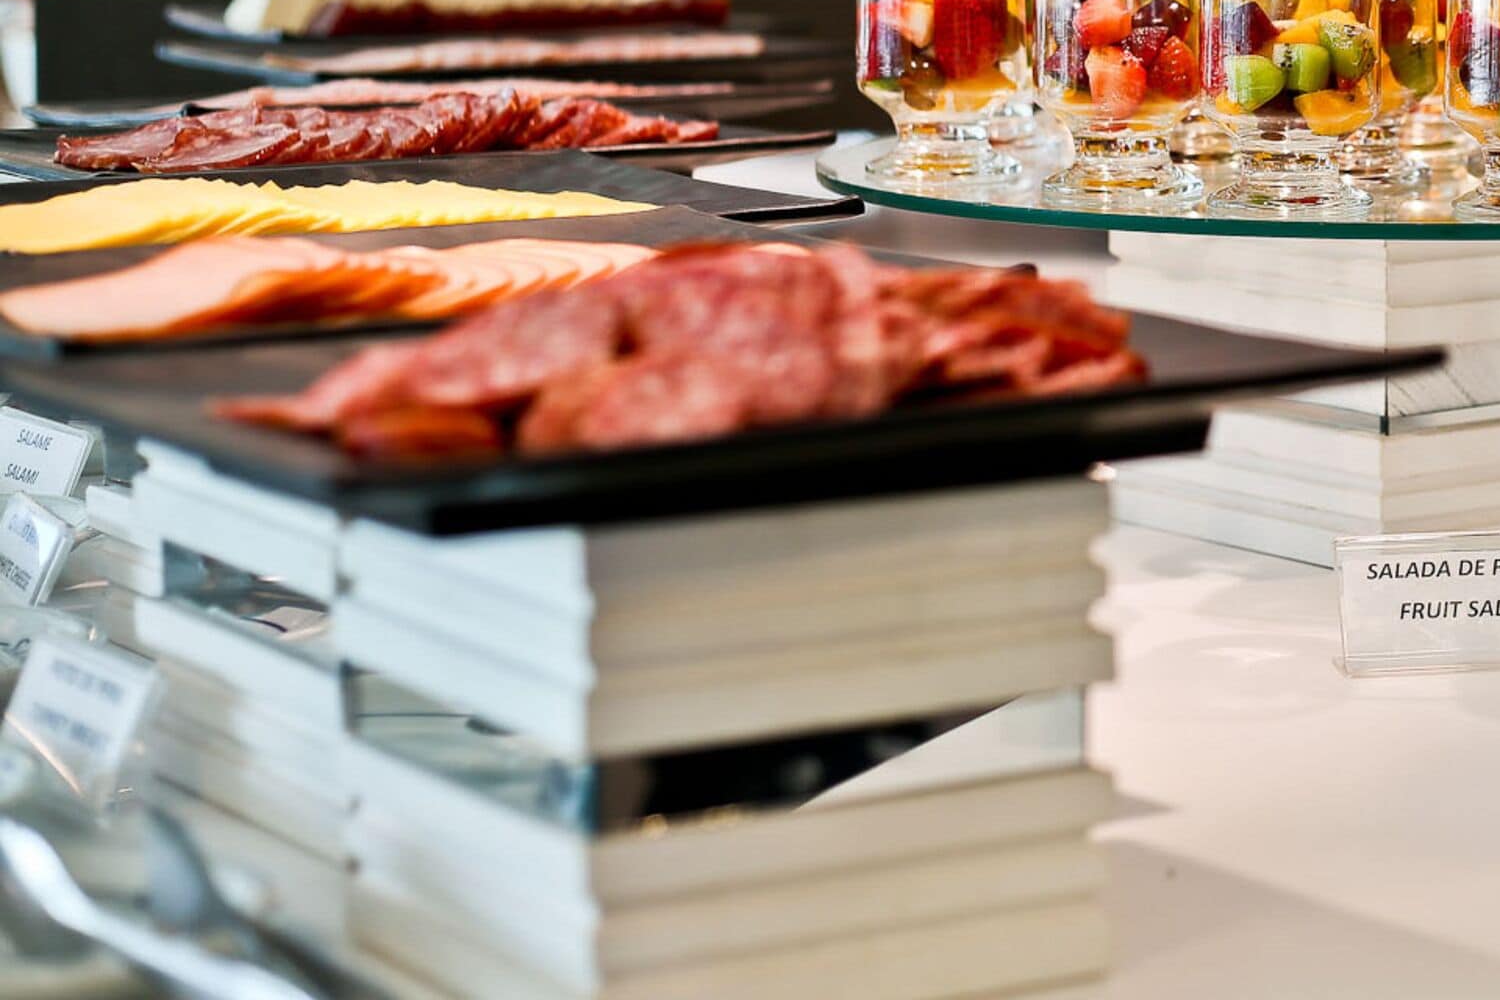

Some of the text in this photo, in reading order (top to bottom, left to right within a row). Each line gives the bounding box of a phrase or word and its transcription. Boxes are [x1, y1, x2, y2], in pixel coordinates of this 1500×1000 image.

[17, 429, 53, 451] SALAME
[4, 463, 40, 484] SALAMI
[1367, 560, 1451, 580] SALADA
[1458, 559, 1486, 576] DE
[1400, 601, 1462, 620] FRUIT
